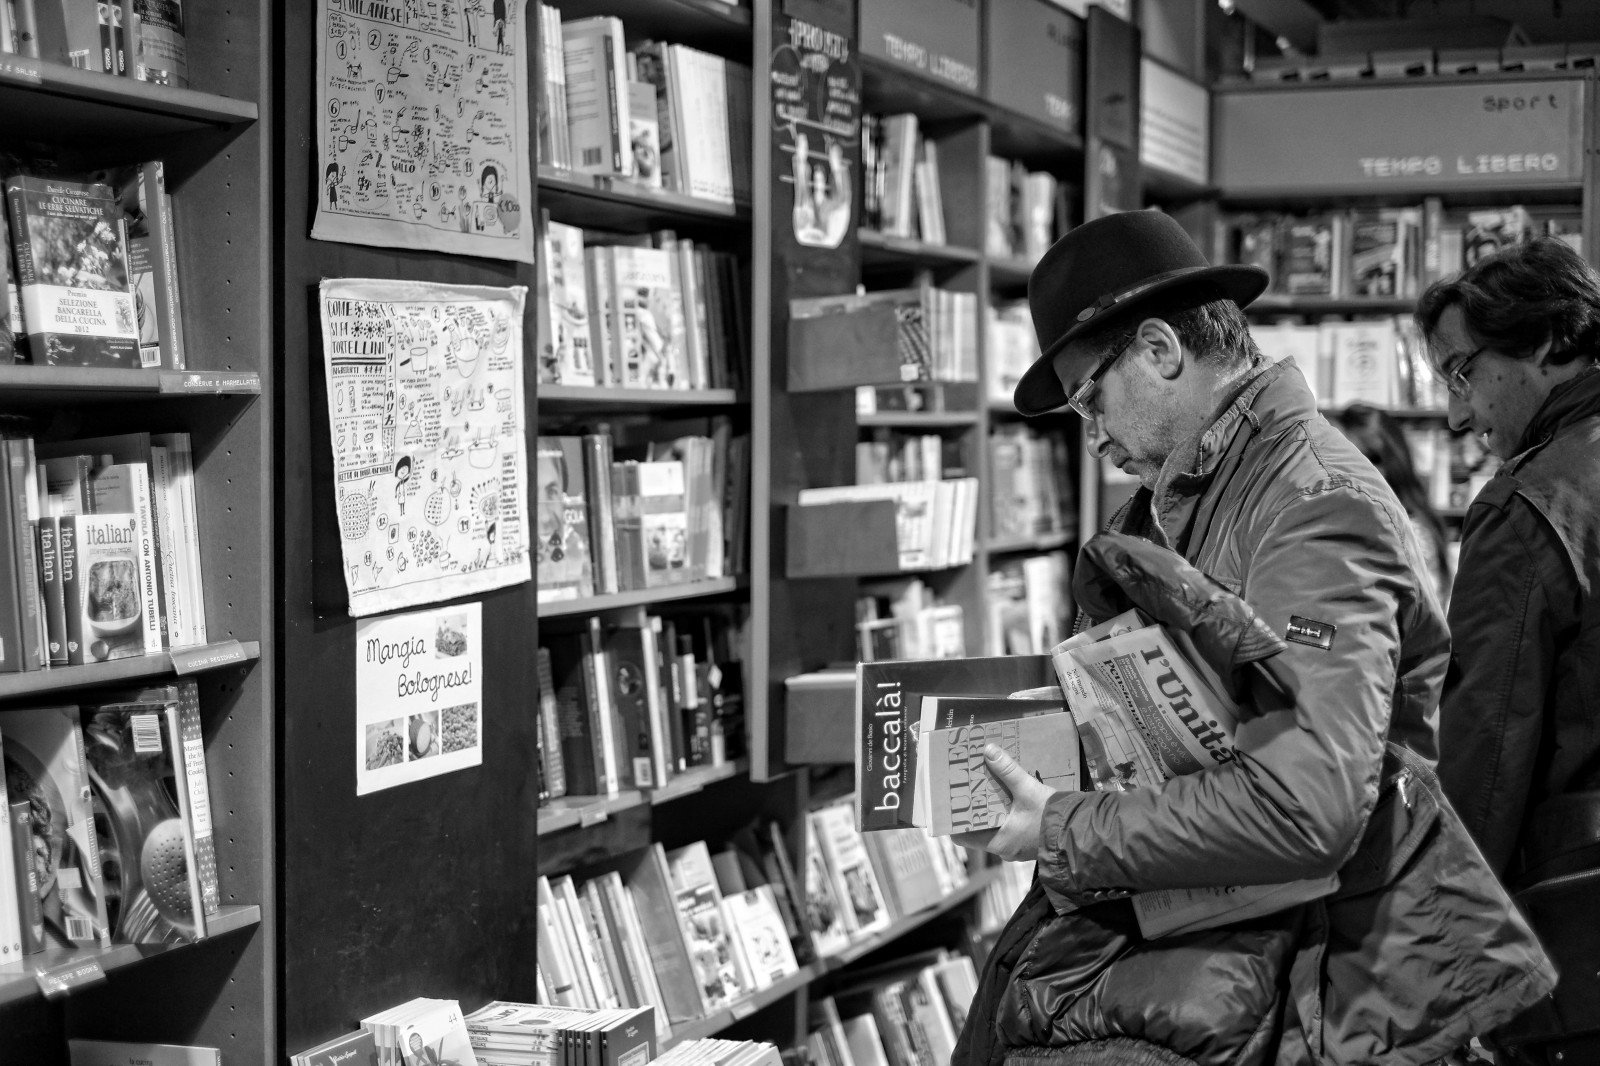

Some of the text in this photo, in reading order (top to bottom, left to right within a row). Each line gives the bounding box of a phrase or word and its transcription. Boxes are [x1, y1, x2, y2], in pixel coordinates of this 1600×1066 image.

[339, 43, 345, 56] 1
[370, 34, 377, 47] 2
[330, 101, 338, 115] 6
[1483, 94, 1559, 113] Sport
[1359, 153, 1559, 178] TEMPO LIBERO
[38, 202, 47, 210] LE
[48, 203, 64, 211] ERBE
[64, 204, 104, 216] SELVATICHE
[52, 196, 87, 207] CUCINARE
[60, 298, 98, 309] SELEZIONE
[68, 290, 88, 298] Premio
[58, 306, 102, 317] BANCARELLA
[328, 300, 352, 317] COME
[55, 314, 107, 326] DELLA CUCINA
[74, 325, 90, 333] 2012
[332, 340, 385, 355] TORTELLINI
[184, 380, 213, 388] CONSERVE
[222, 378, 257, 387] MARMELLATE
[140, 505, 149, 536] TAVOLA
[86, 524, 132, 545] italian
[41, 528, 55, 583] italian
[61, 528, 75, 582] italian
[144, 559, 153, 596] ANTONIO
[166, 550, 176, 588] Cucina
[148, 598, 157, 631] TUBELLI
[366, 636, 426, 669] Mangia
[398, 662, 473, 703] Bolognese!
[1076, 678, 1089, 700] mondo
[874, 681, 902, 811] baccalà!
[948, 727, 972, 832] JULES
[969, 725, 989, 828] RENARD
[87, 816, 101, 880] Buonissimo!
[77, 964, 99, 978] BOOKS
[448, 1013, 457, 1024] 44
